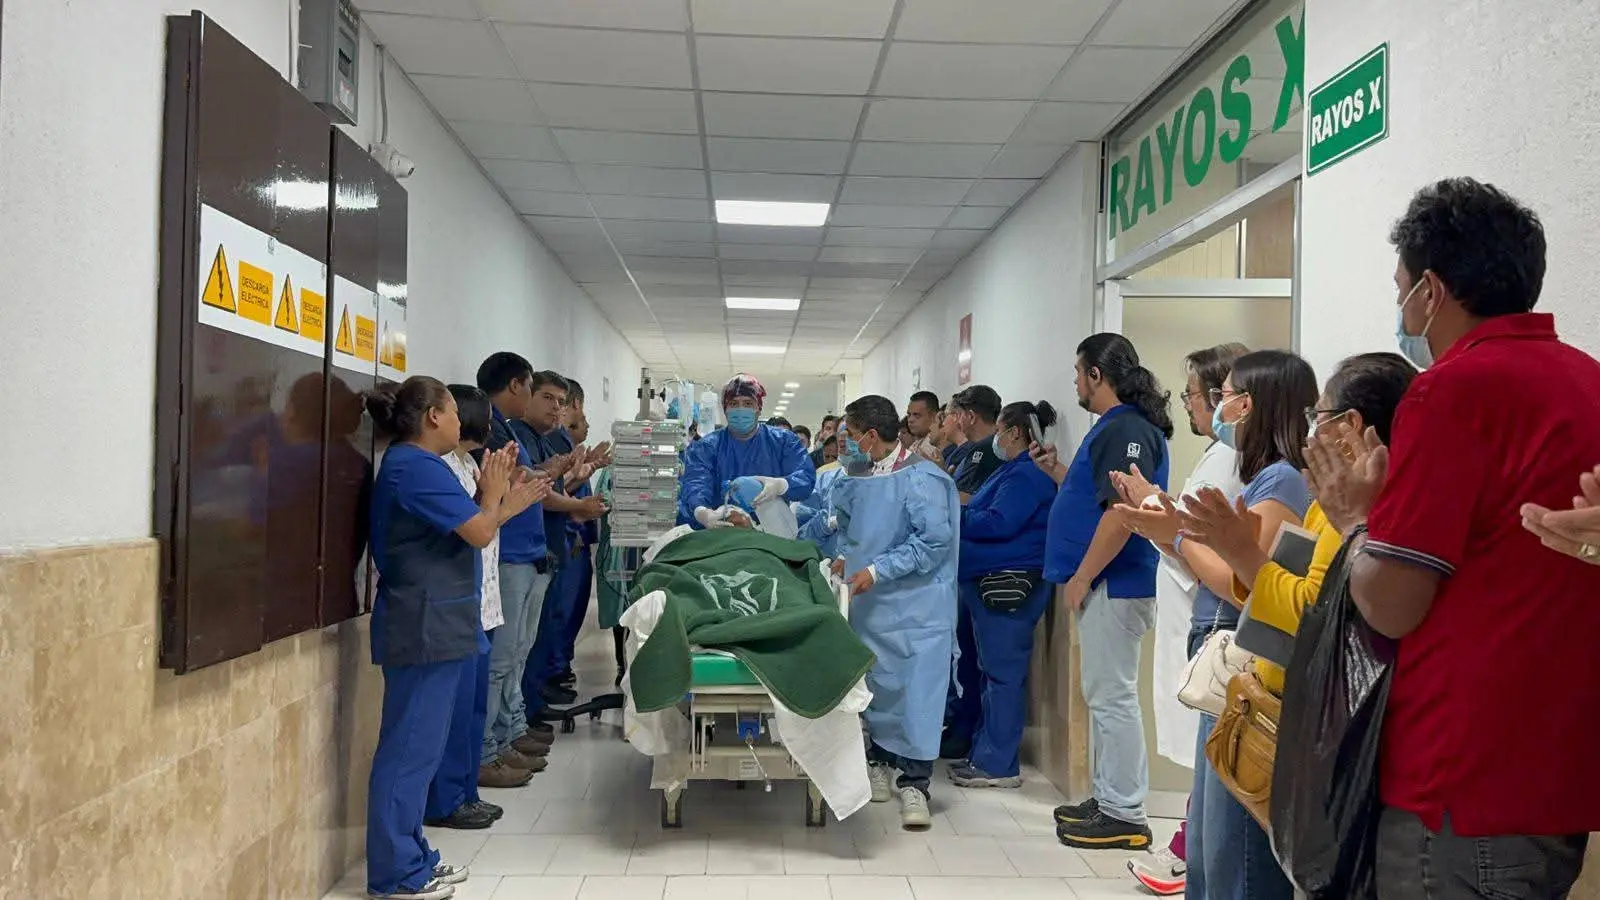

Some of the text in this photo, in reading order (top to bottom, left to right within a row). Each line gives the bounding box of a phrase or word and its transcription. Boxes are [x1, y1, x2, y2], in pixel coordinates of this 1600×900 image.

[1110, 8, 1305, 241] RAYOS X
[1312, 76, 1381, 147] RAYOS X
[242, 276, 269, 295] DESCARGA
